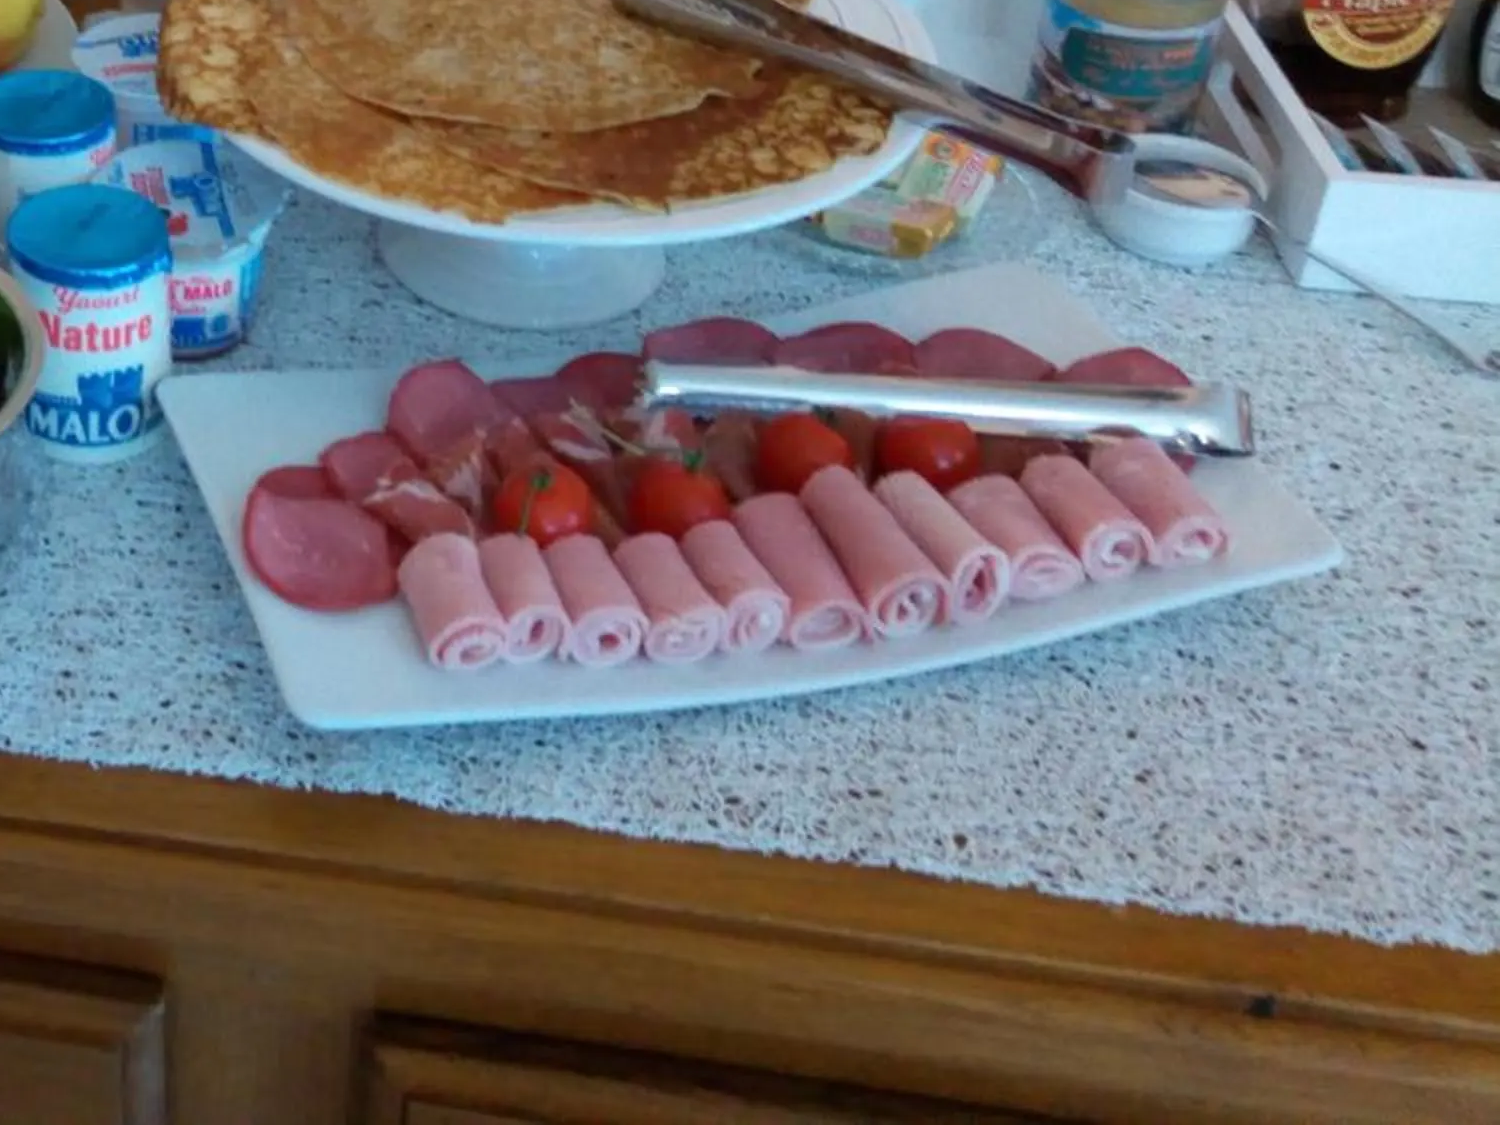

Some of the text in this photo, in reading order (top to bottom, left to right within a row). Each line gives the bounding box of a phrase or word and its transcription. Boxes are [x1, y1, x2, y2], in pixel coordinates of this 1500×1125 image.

[184, 279, 232, 301] MALO
[38, 314, 153, 352] Nature
[28, 402, 140, 444] MALO
